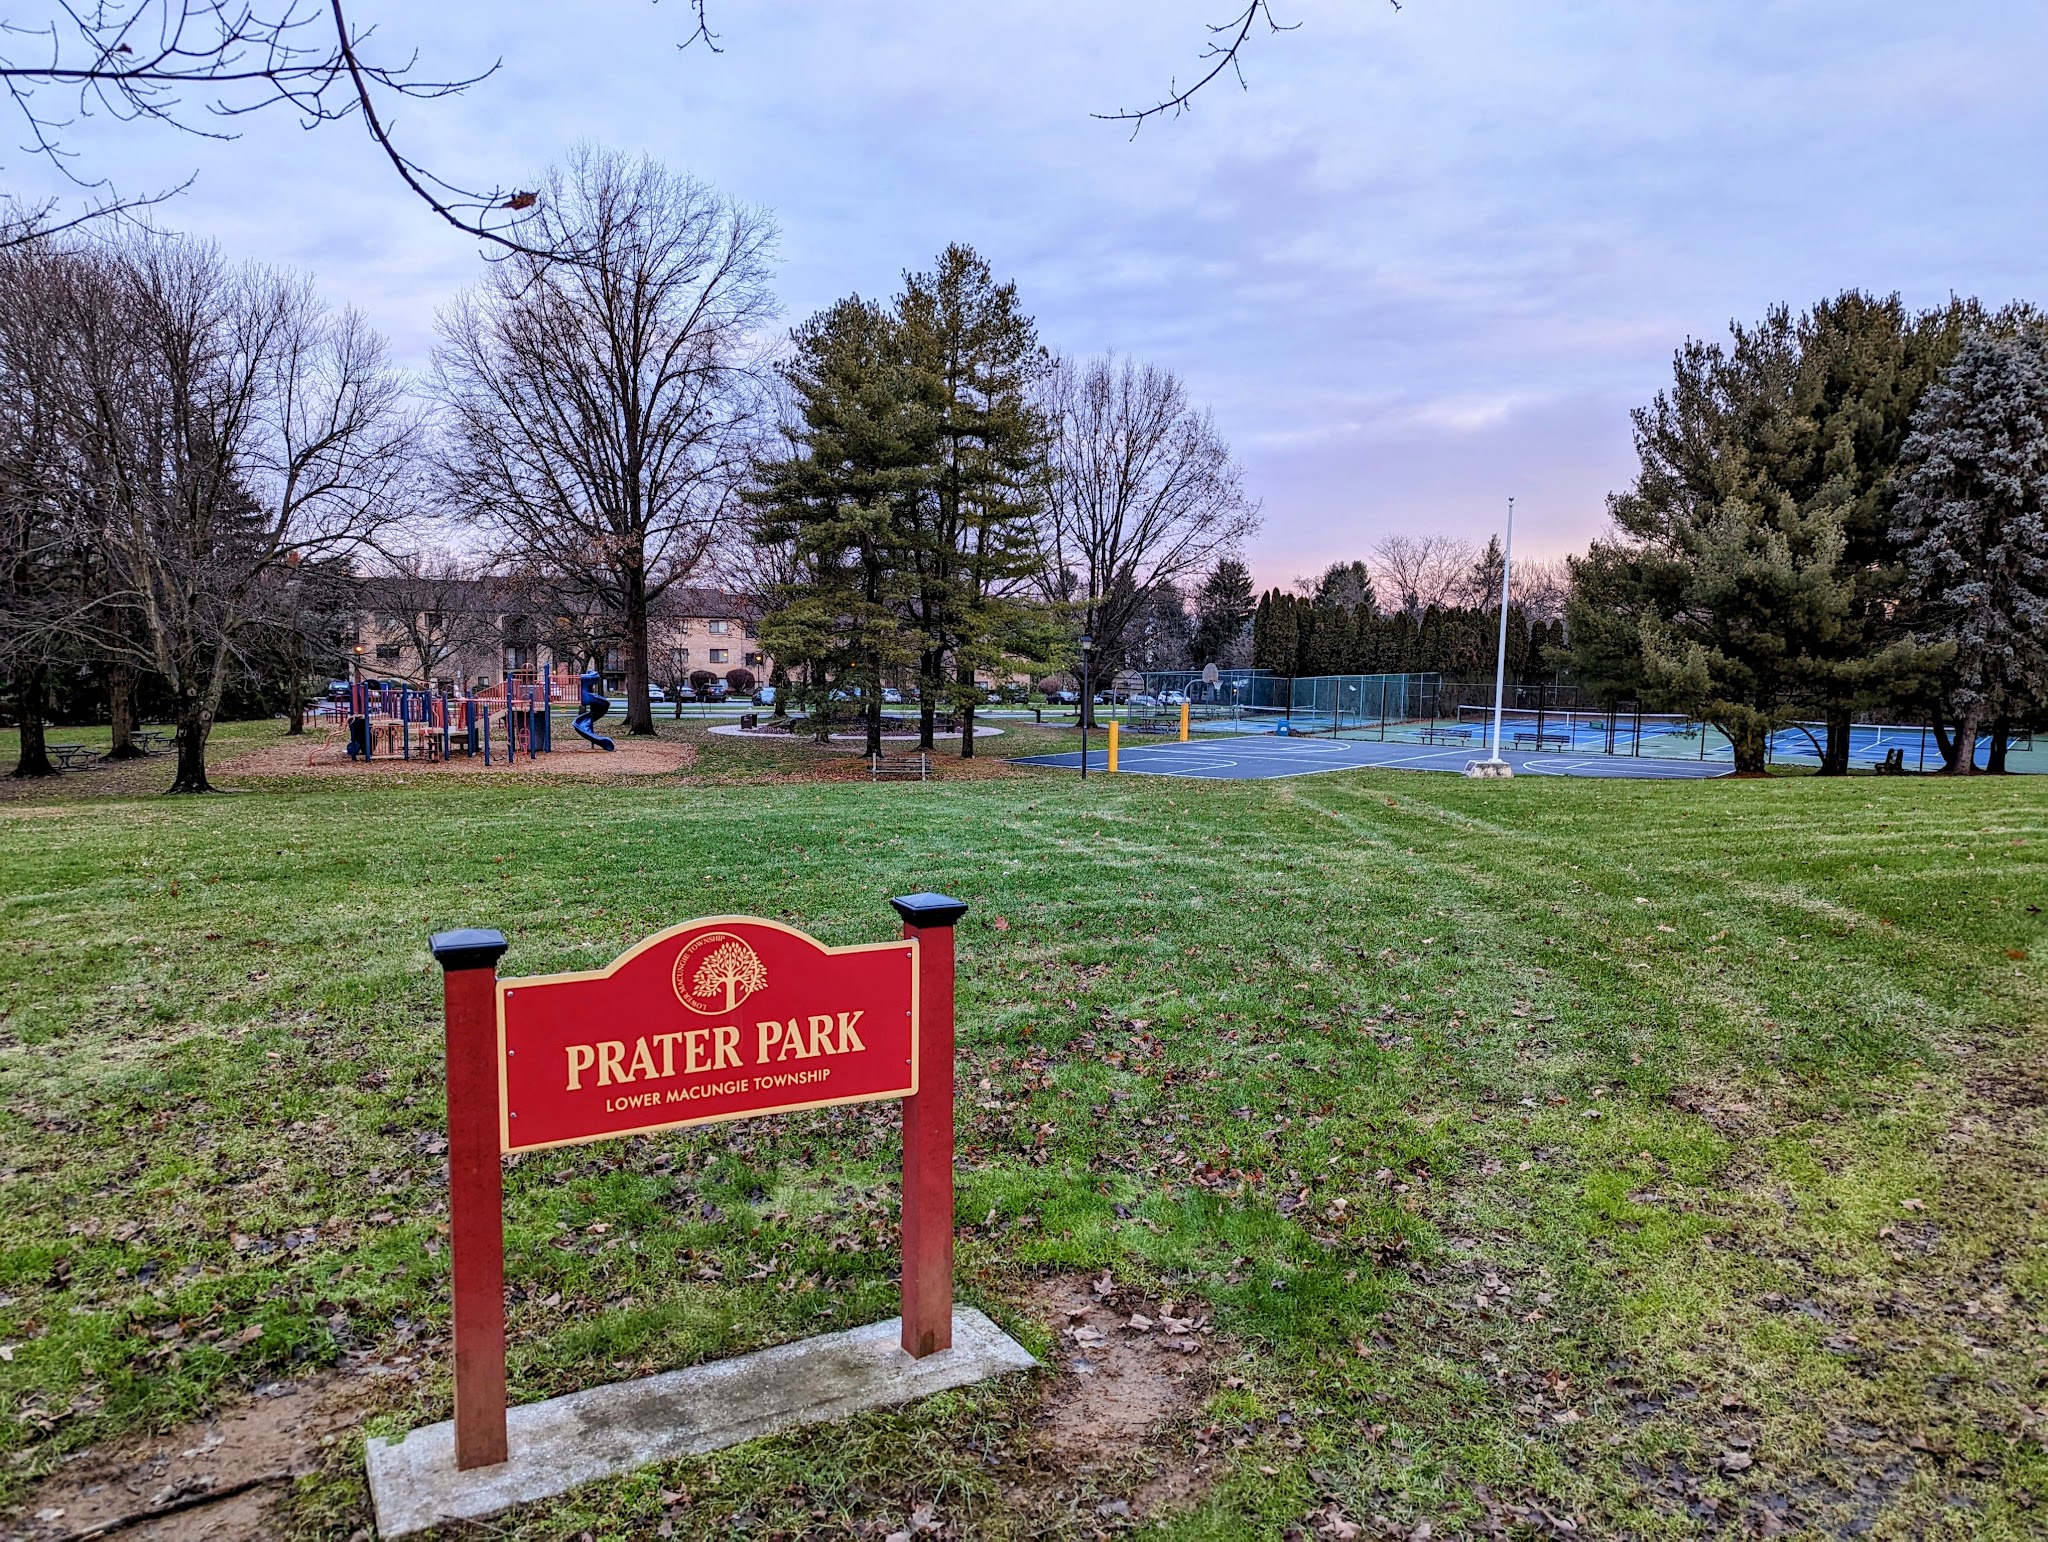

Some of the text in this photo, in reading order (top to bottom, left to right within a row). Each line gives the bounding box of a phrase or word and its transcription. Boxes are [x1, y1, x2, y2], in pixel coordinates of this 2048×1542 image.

[676, 935, 726, 1011] LOWER MACUNGIE TOWNSHIP
[565, 1010, 866, 1091] PRATER PARK
[605, 1068, 832, 1113] LOWER MACUNGIE TOWNSHIP
